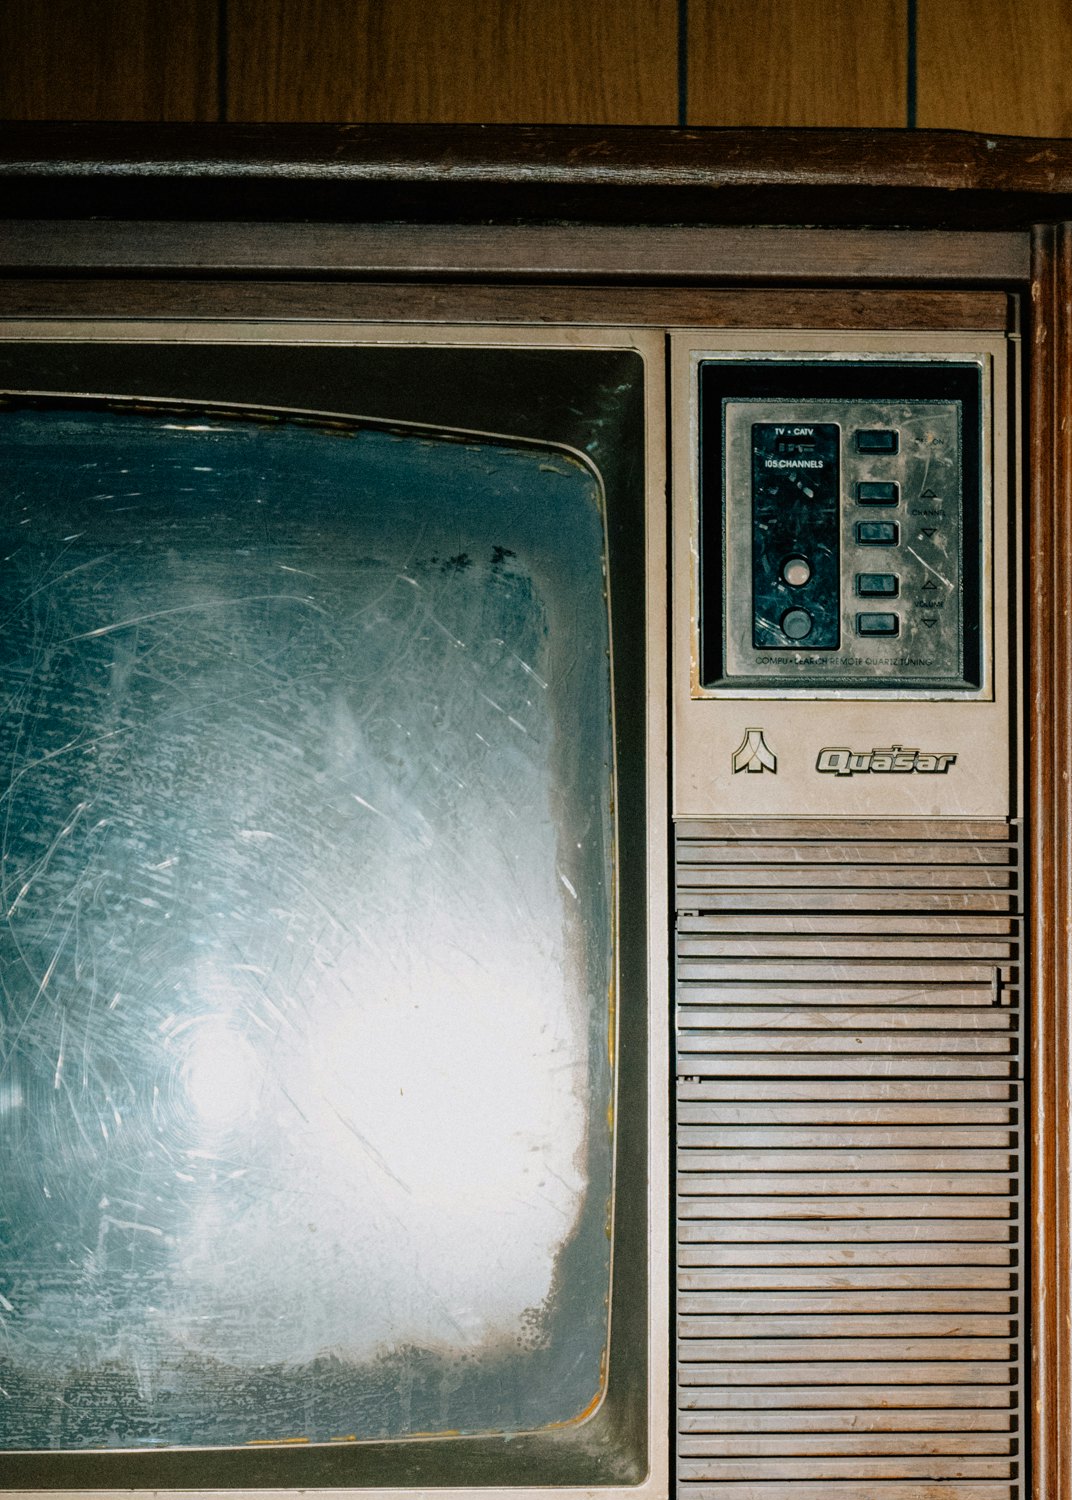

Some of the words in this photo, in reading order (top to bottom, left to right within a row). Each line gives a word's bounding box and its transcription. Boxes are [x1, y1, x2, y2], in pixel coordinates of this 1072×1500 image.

[765, 460, 778, 468] 105
[779, 460, 824, 468] CHANNELS
[755, 656, 788, 665] COMPU
[899, 658, 933, 666] TUNING
[815, 745, 959, 777] Quasar
